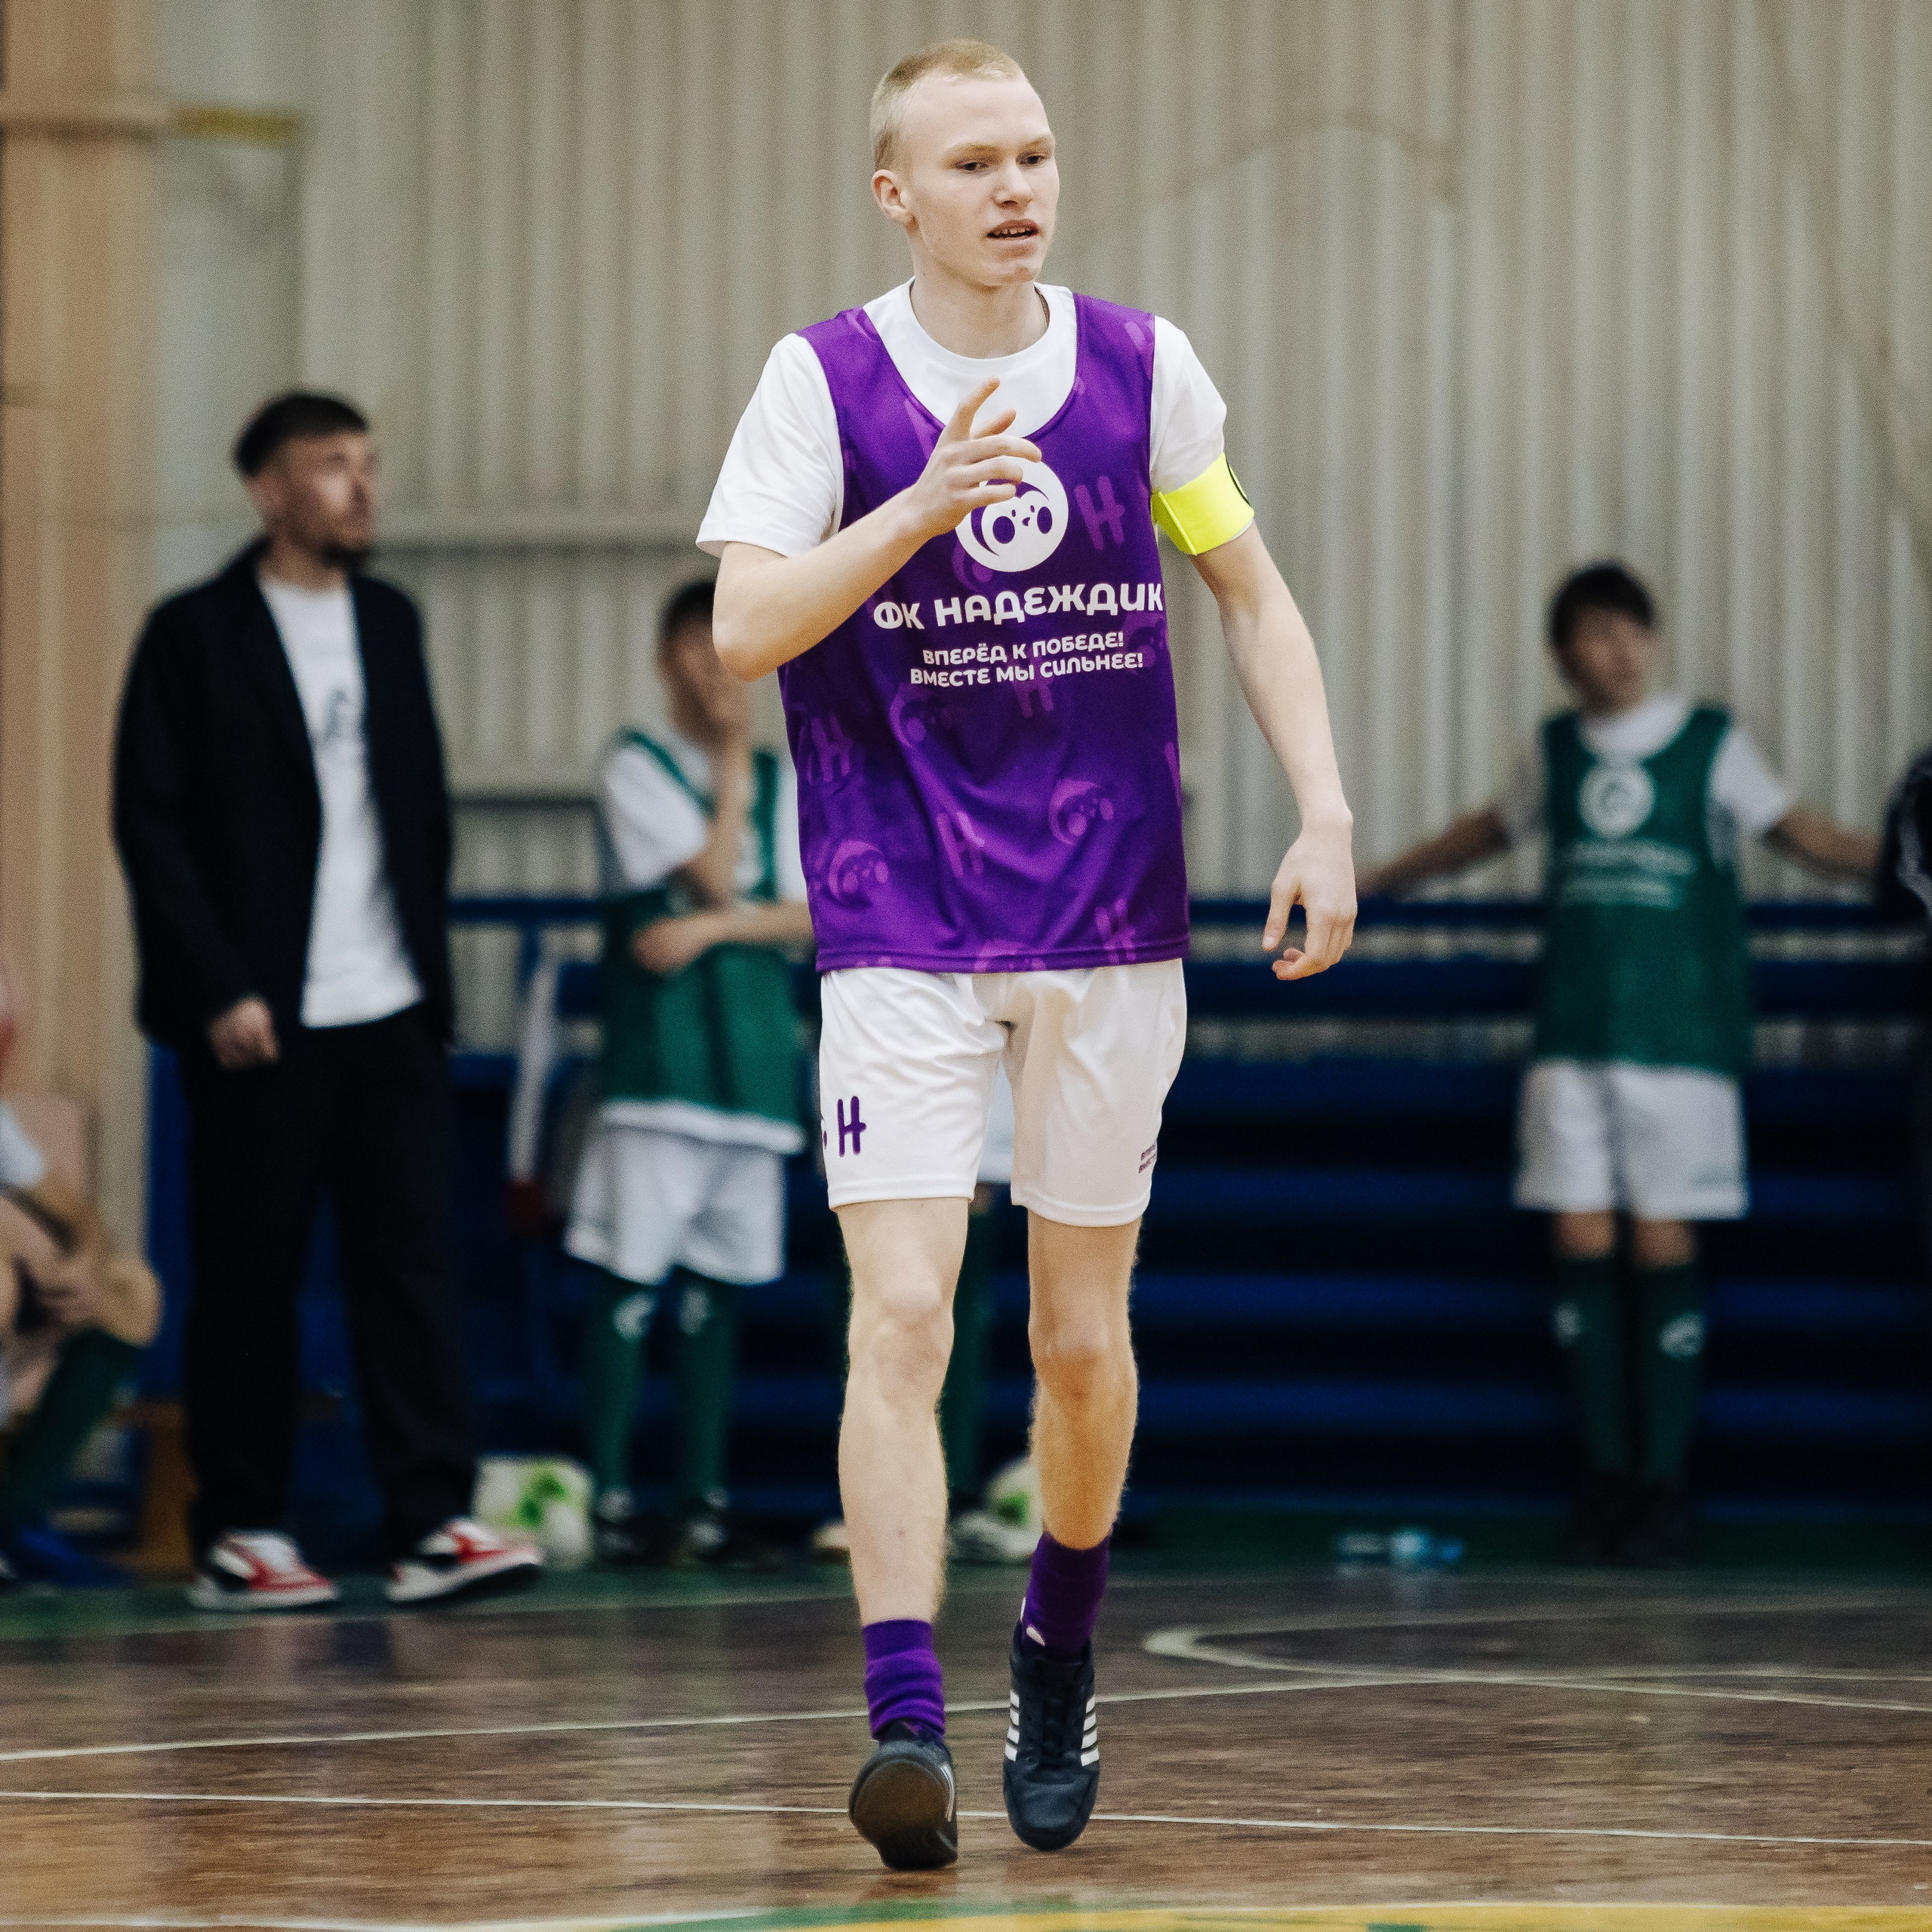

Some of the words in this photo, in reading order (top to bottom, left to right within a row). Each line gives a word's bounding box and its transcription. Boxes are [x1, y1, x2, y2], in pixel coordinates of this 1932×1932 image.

[873, 601, 925, 629] ФК
[934, 583, 1164, 626] НАДЕЖДИК
[922, 642, 1008, 666] ВПЕРЁД
[1013, 643, 1027, 660] К
[1032, 631, 1124, 658] ПОБЕДЕ!
[910, 668, 990, 688] ВМЕСТЕ
[996, 664, 1035, 682] МЫ
[1040, 652, 1144, 678] СИЛЬНЕЕ!
